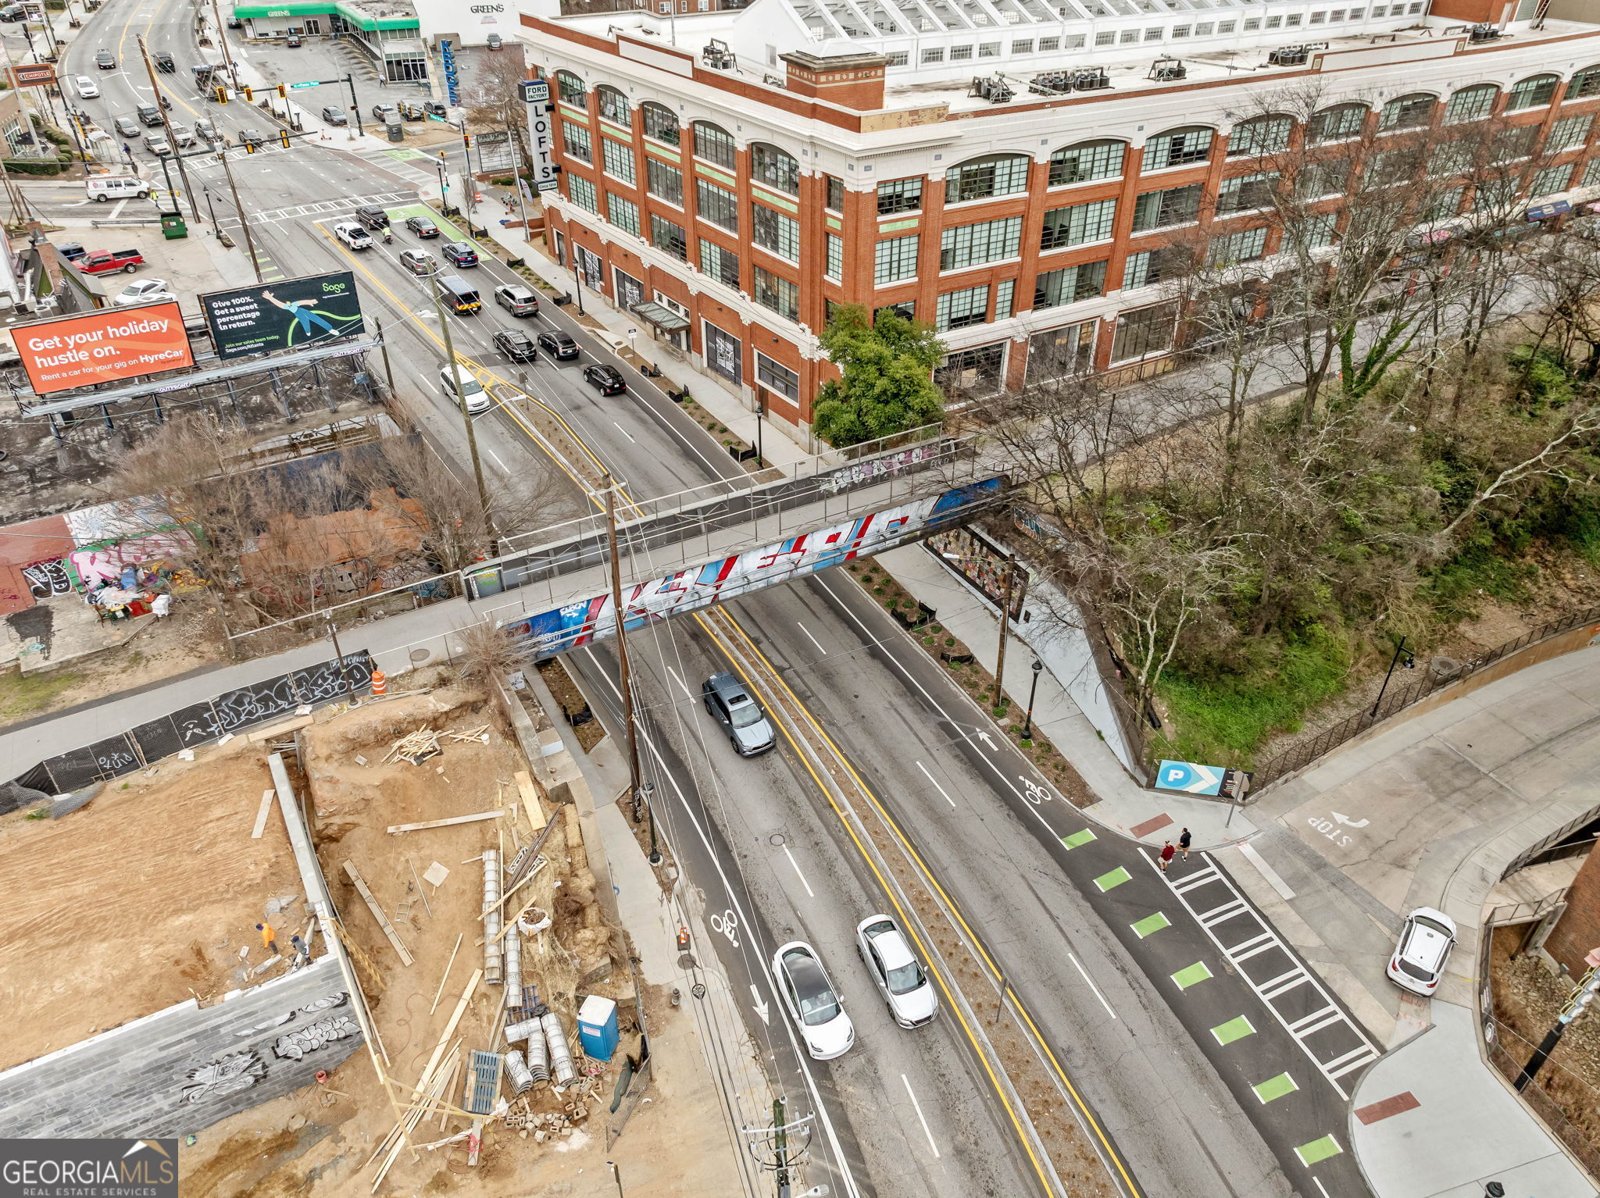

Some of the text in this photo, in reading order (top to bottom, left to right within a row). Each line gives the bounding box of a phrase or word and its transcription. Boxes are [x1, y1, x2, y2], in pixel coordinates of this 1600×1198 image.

[25, 71, 50, 79] CHIPOTLE
[527, 86, 547, 94] FORD
[535, 105, 551, 178] LOFTS
[322, 282, 345, 294] Sage
[212, 295, 254, 309] Give 100%.
[214, 306, 230, 316] Get
[235, 303, 258, 313] sweet
[216, 311, 260, 325] percentage
[218, 319, 255, 331] in return.
[28, 319, 169, 351] Get your holiday
[34, 345, 120, 368] hustle on.
[40, 373, 60, 382] Rent
[68, 369, 81, 377] car
[82, 366, 94, 374] for
[95, 364, 112, 373] your
[114, 360, 127, 369] gig
[139, 349, 184, 364] HyreCar
[1168, 769, 1185, 782] P
[1308, 817, 1352, 847] STOP
